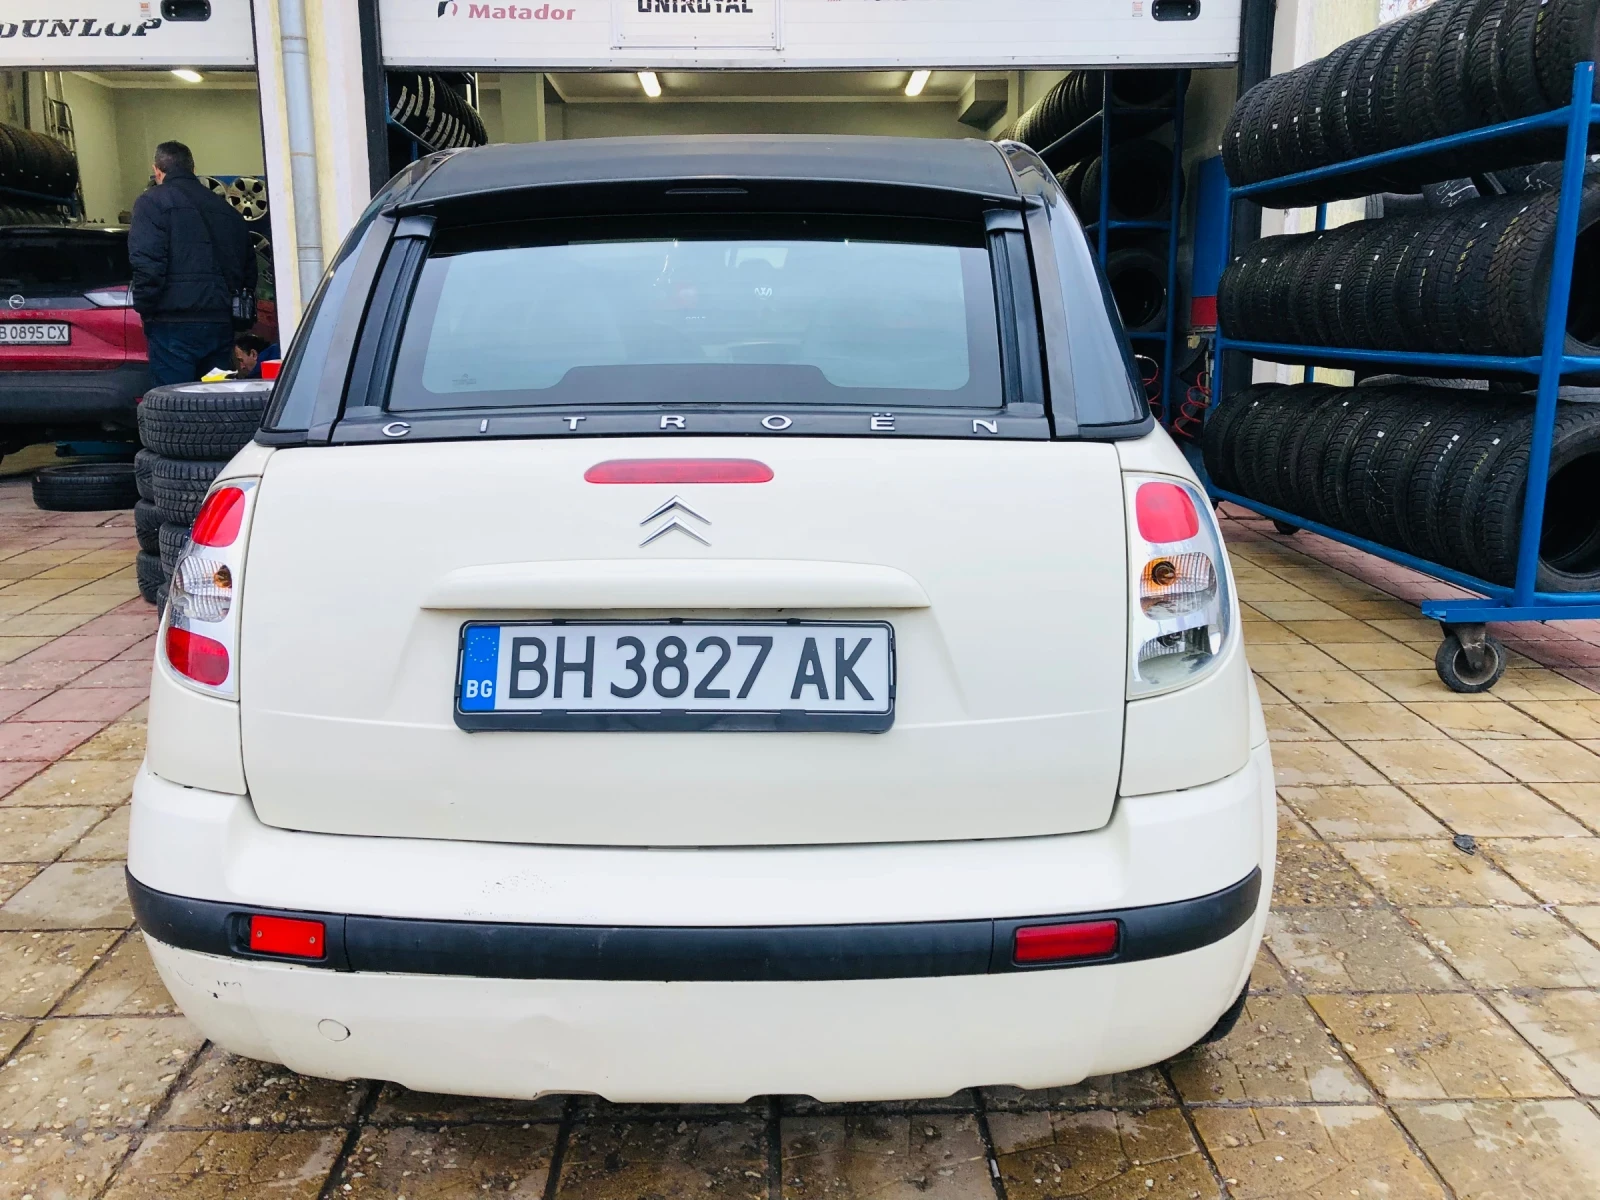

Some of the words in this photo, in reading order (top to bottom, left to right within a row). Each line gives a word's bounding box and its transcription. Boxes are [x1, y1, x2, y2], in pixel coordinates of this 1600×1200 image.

[468, 4, 576, 20] Matador
[0, 18, 162, 38] DUNLOP
[10, 326, 44, 339] 0895
[47, 326, 66, 339] CX
[382, 413, 998, 437] CITROËN
[509, 636, 595, 699] BH
[610, 636, 774, 699] 3827
[791, 637, 875, 700] AK
[466, 680, 493, 698] BG
